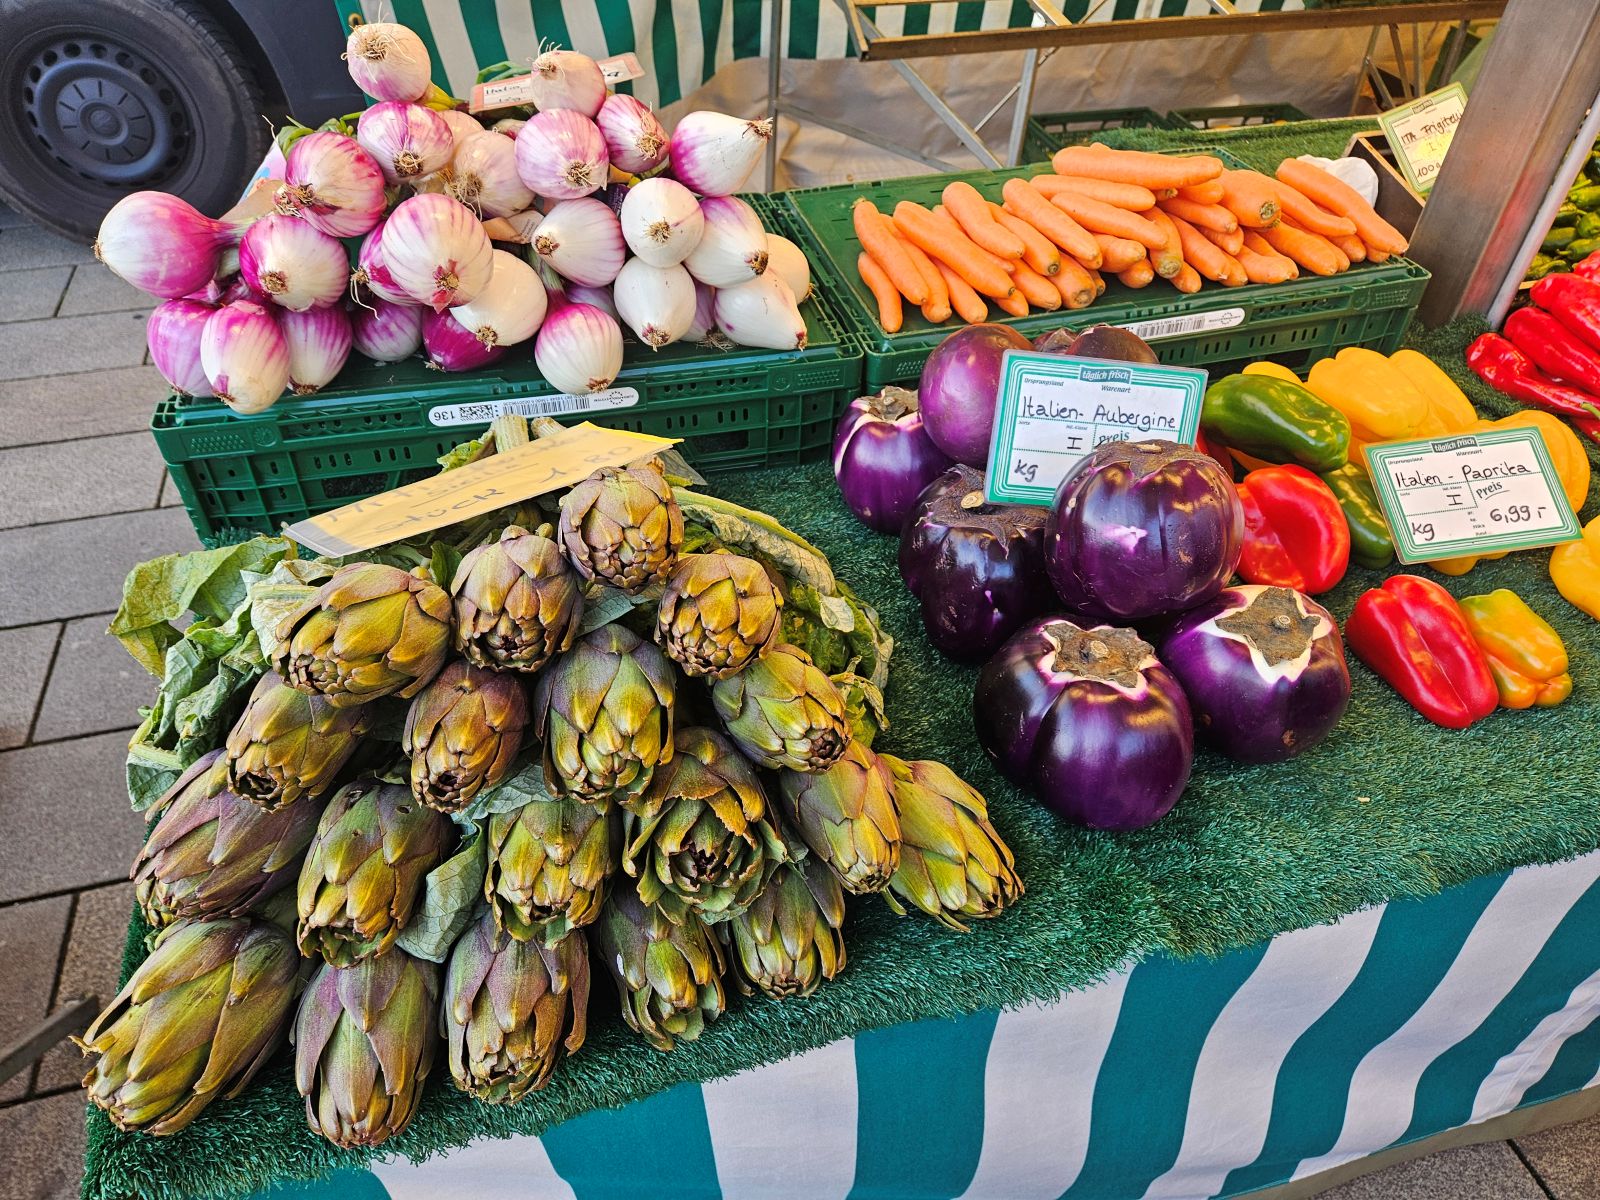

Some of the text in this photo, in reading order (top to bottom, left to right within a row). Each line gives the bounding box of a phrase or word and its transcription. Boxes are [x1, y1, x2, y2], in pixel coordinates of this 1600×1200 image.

[1401, 131, 1417, 144] ITA
[1417, 165, 1435, 178] 100
[1082, 370, 1130, 382] täglich frisch
[1101, 384, 1131, 394] Warenart
[433, 409, 455, 421] 136
[1093, 404, 1176, 432] Aubergine
[1066, 436, 1083, 450] I
[1434, 438, 1475, 452] täglich frisch
[1014, 459, 1039, 482] kg
[1395, 470, 1442, 488] Italien
[1462, 461, 1532, 483] Paprika
[1476, 481, 1503, 499] Preis
[1446, 494, 1463, 506] I
[1411, 522, 1436, 541] kg
